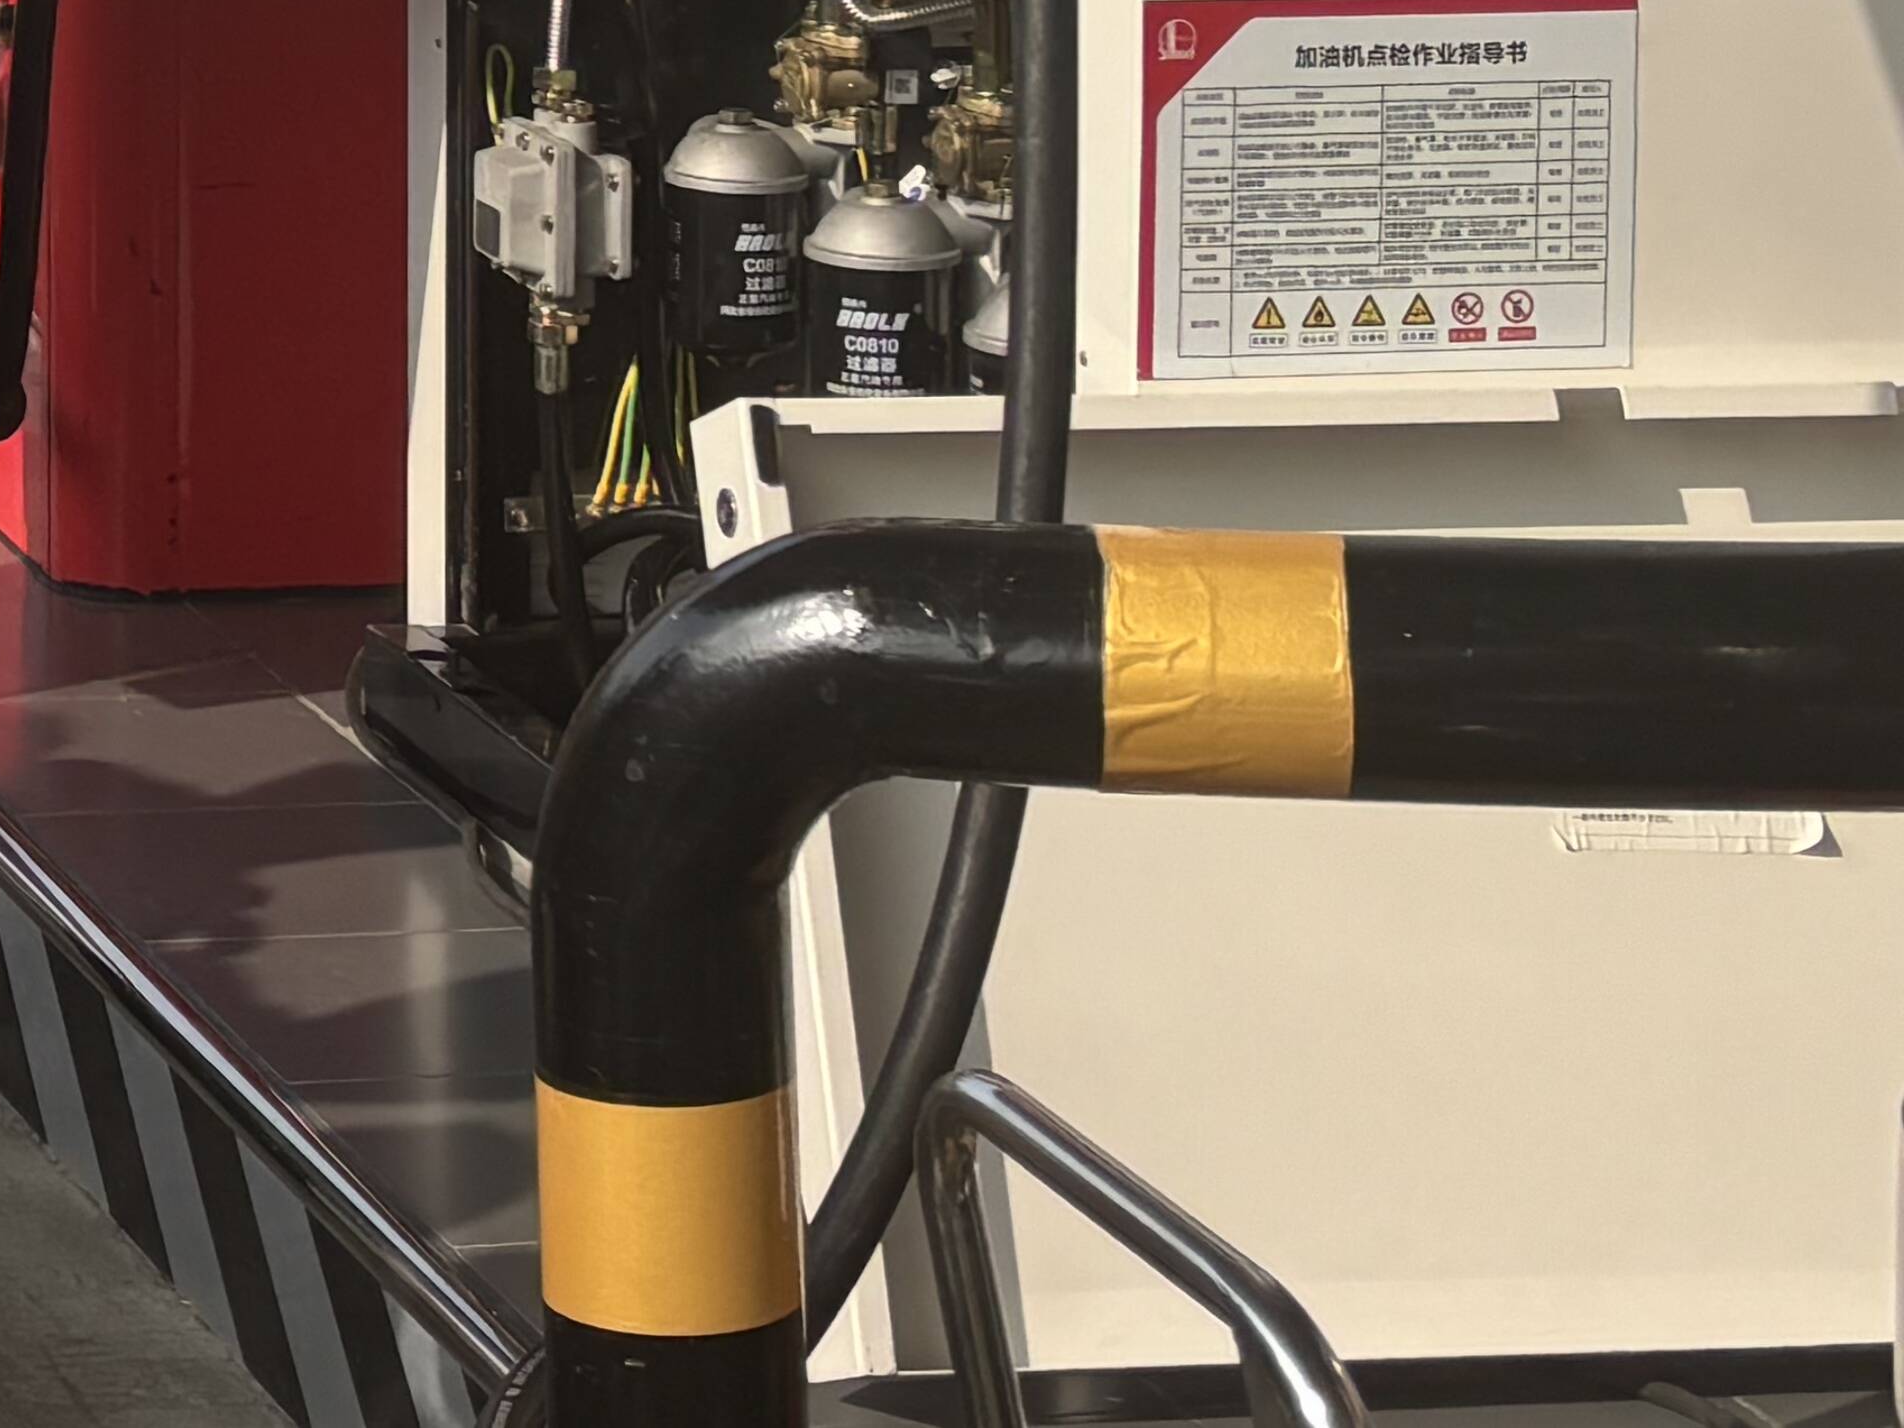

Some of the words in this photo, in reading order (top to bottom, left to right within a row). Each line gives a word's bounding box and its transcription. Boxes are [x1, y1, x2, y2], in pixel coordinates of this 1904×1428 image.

[1295, 40, 1528, 70] 加油机点检作业指导书
[844, 335, 900, 354] C0810
